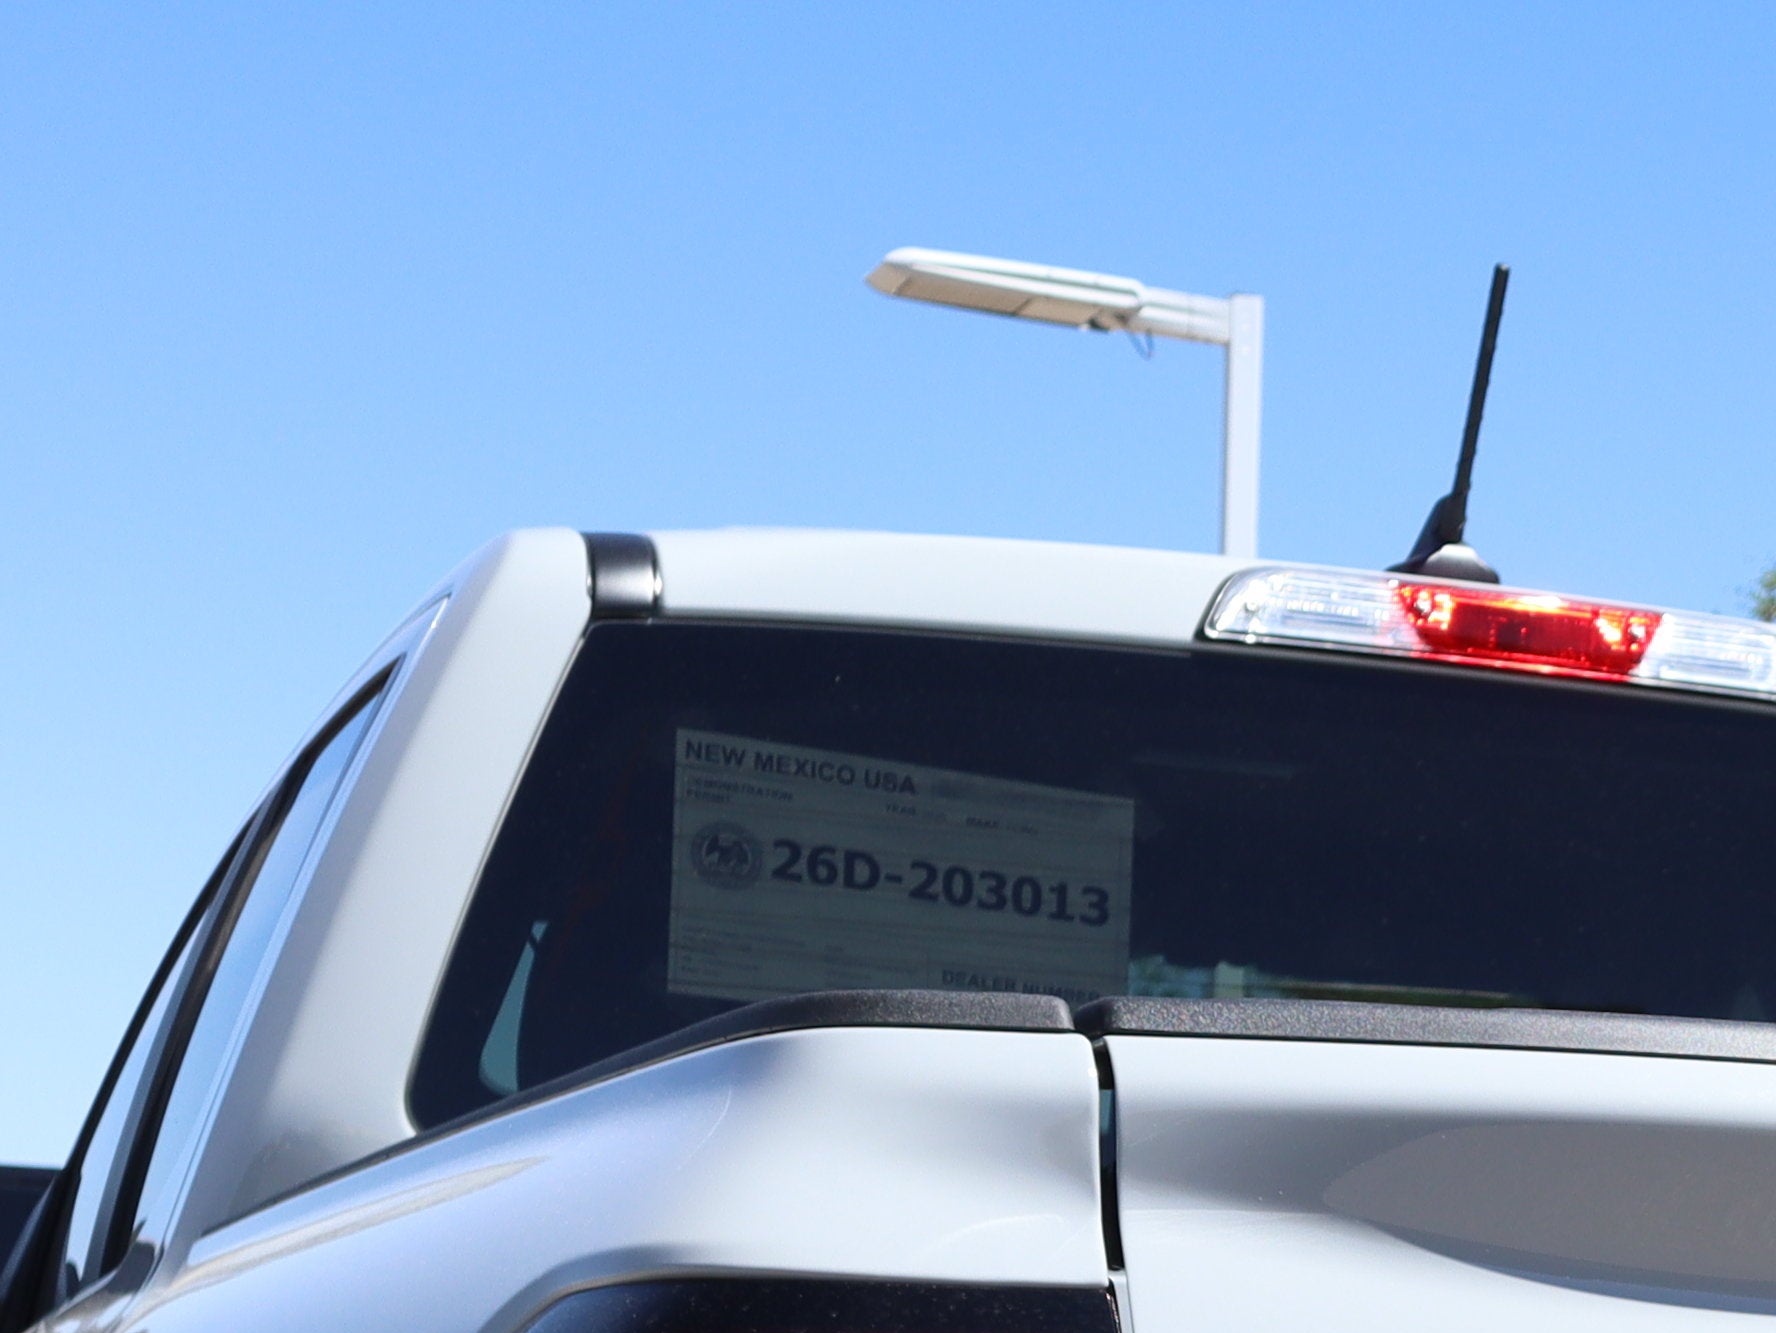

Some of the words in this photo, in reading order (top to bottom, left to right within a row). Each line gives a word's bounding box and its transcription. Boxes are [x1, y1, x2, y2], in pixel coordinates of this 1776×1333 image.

[684, 738, 746, 766] NEW
[753, 751, 854, 785] MEXICO
[864, 770, 917, 796] USA
[771, 837, 1110, 928] 26D-203013
[942, 969, 1016, 992] DEALER
